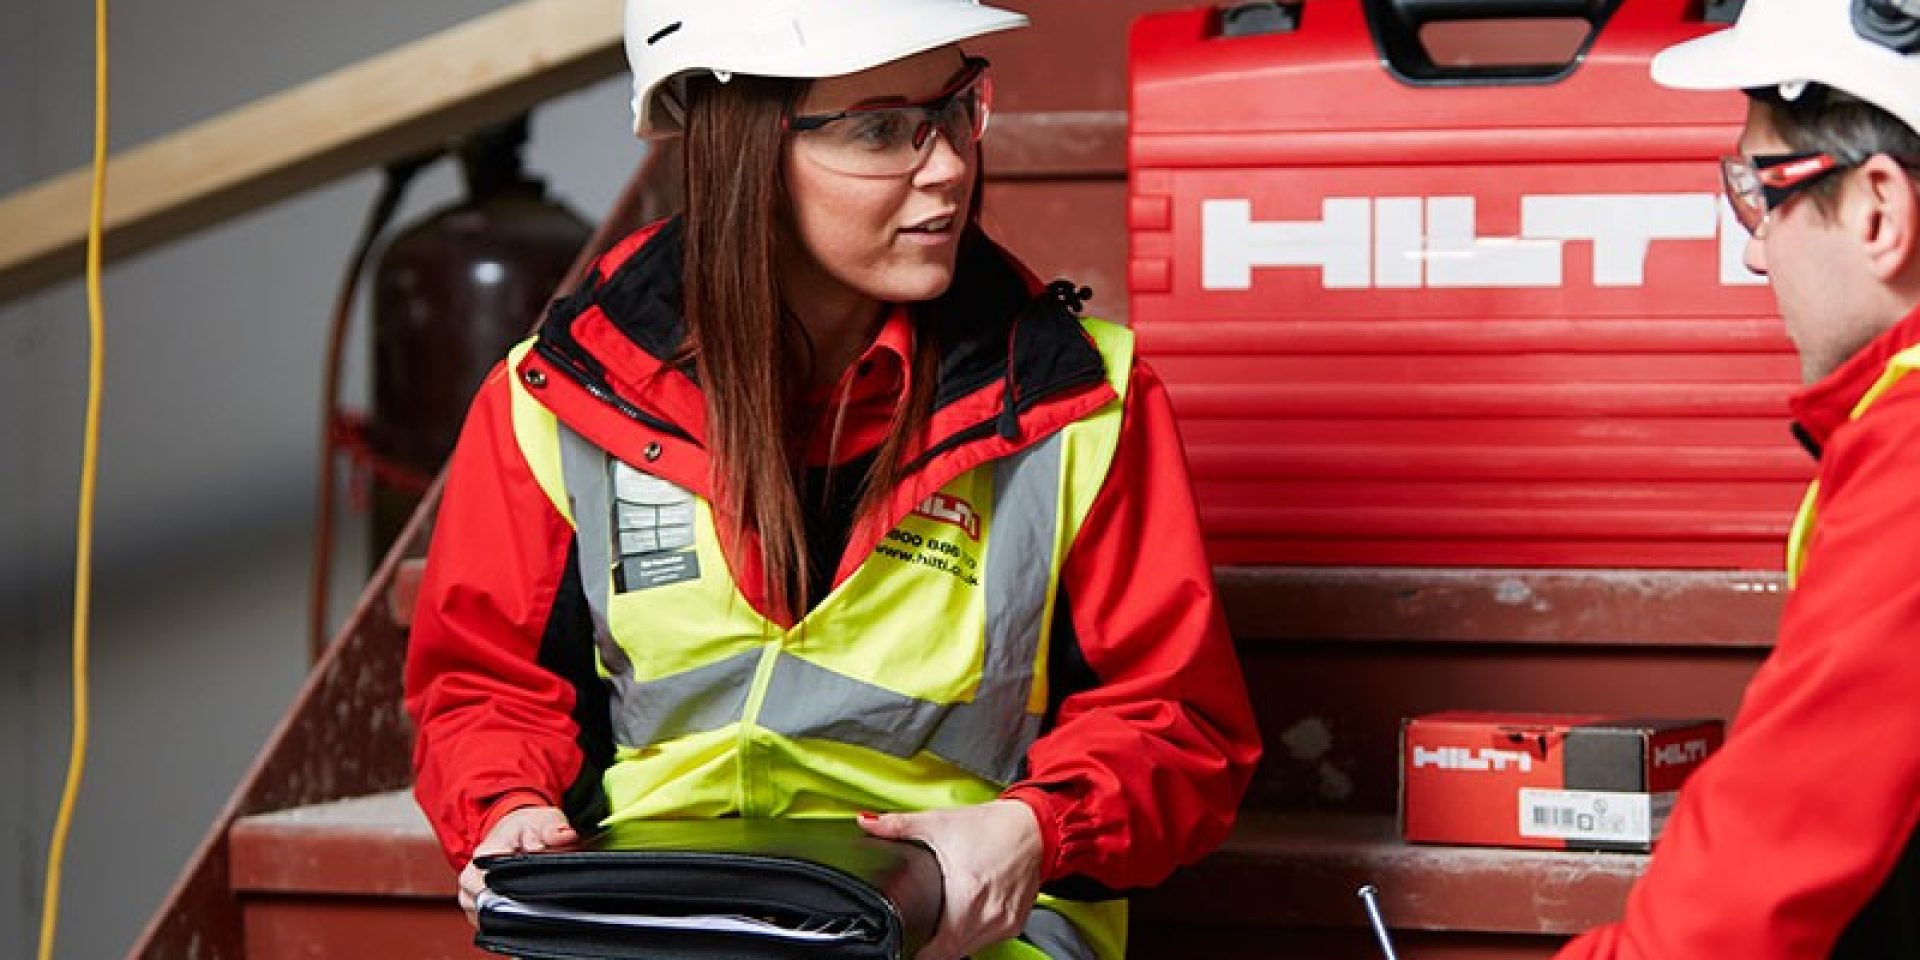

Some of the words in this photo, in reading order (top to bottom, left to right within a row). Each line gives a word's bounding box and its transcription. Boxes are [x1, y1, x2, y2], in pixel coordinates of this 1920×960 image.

[1202, 194, 1769, 288] HILTI
[914, 494, 979, 541] ILTI
[888, 528, 922, 547] 800
[875, 544, 979, 586] www.hilti.o.k
[1413, 745, 1532, 772] HILTI
[1654, 739, 1708, 768] HILTI
